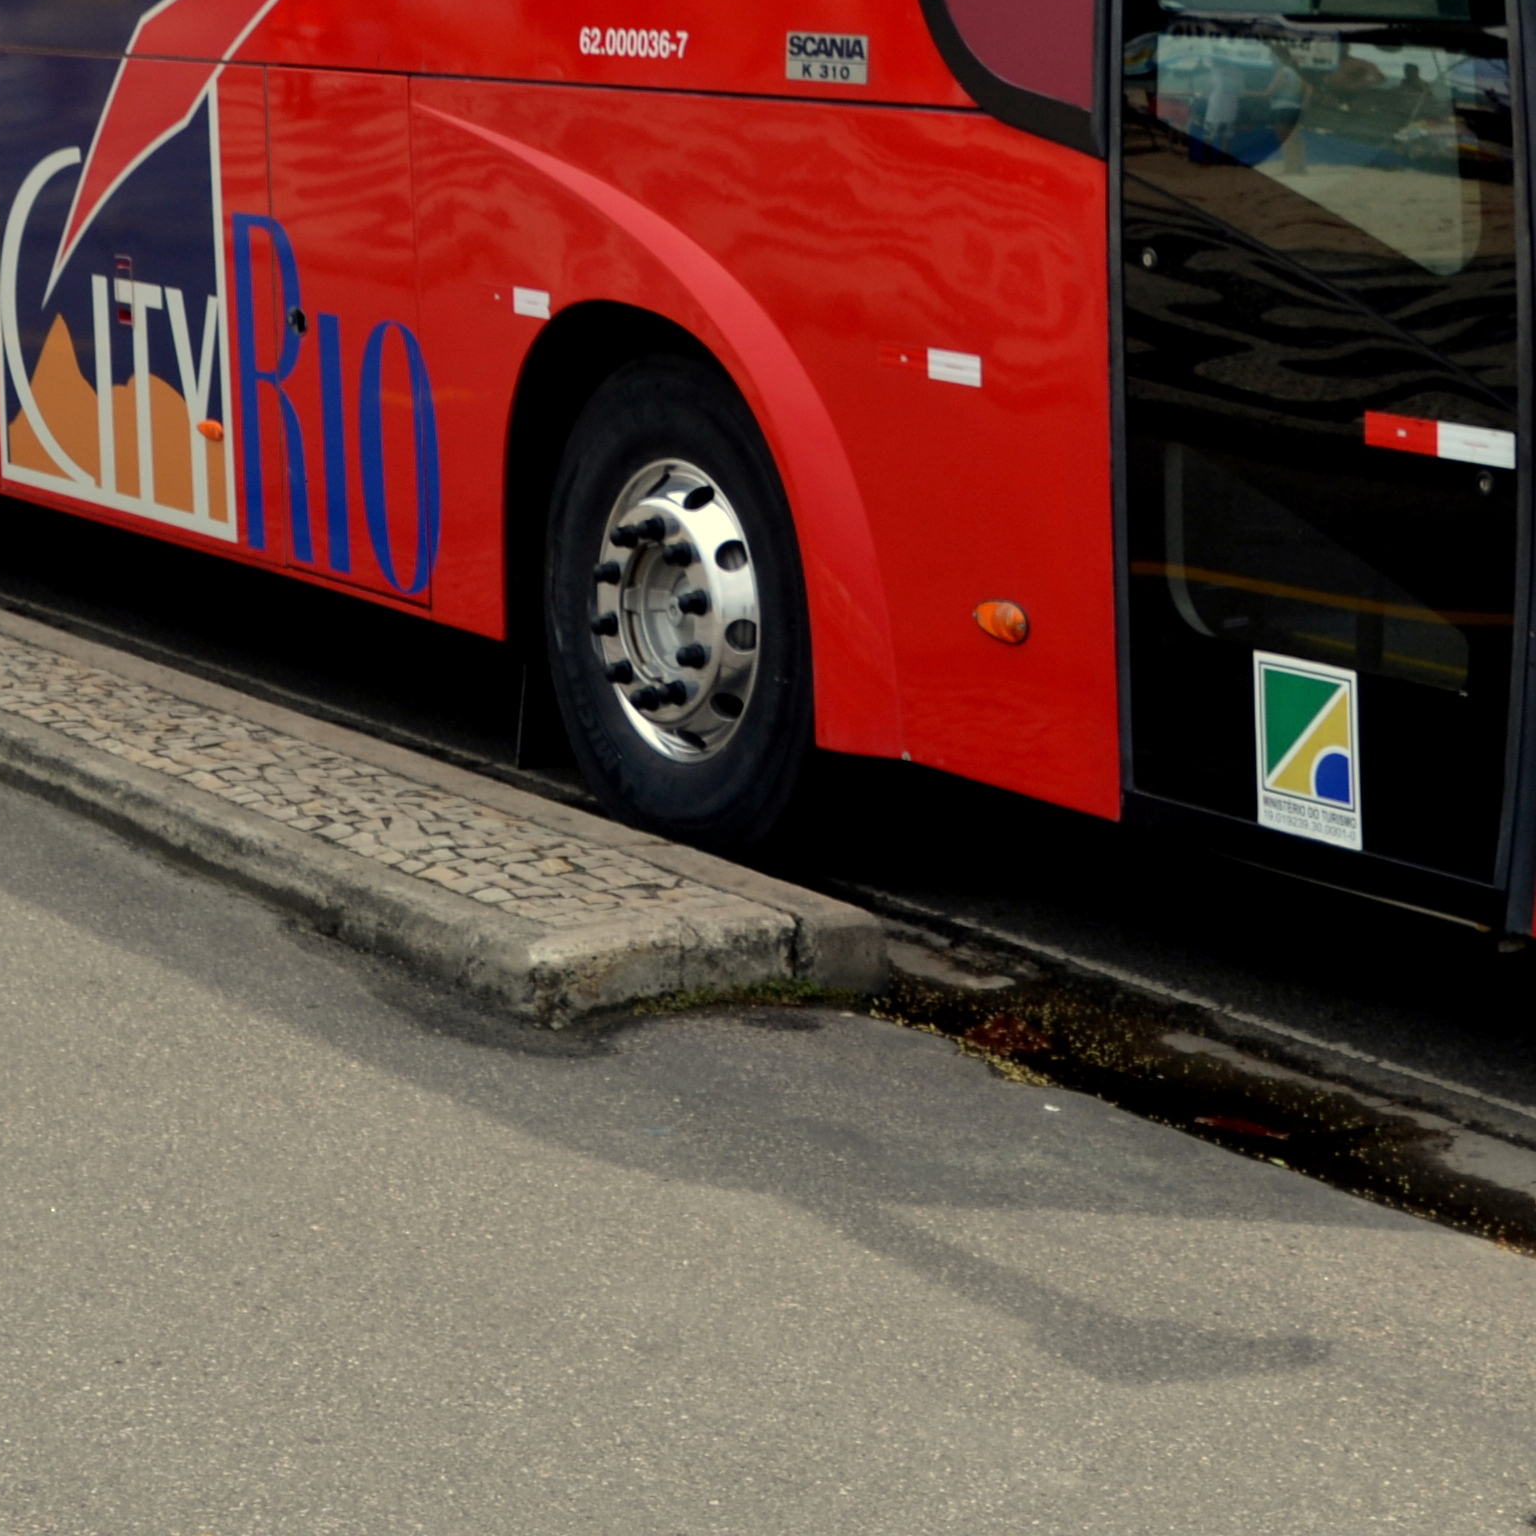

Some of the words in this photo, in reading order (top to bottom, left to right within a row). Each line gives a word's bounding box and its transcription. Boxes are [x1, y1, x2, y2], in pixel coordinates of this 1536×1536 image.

[579, 26, 689, 60] 62.000036-7
[788, 34, 865, 60] SCANIA
[801, 63, 814, 78] K
[819, 64, 851, 80] 310
